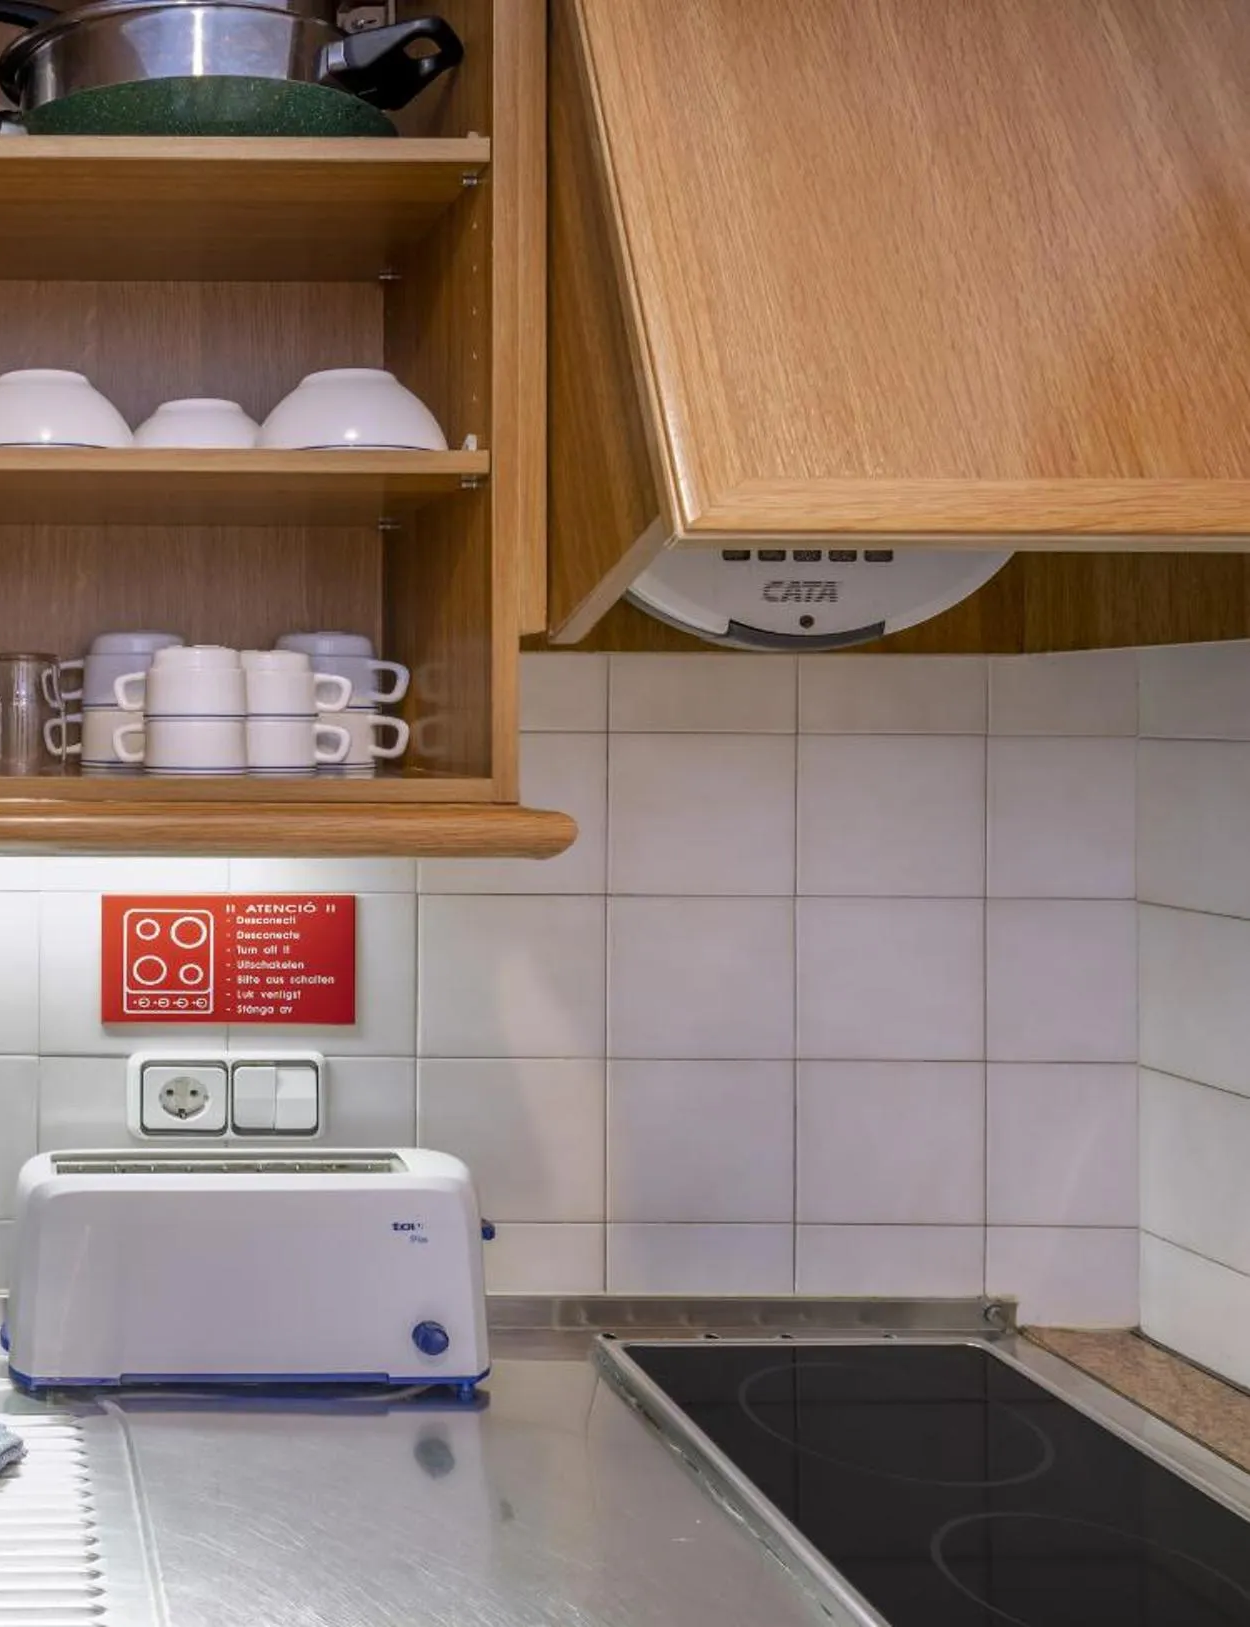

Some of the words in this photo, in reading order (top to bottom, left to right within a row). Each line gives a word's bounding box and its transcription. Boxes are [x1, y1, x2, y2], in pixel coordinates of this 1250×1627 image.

[762, 580, 839, 602] CATA
[246, 901, 317, 913] ATENCIÓ
[266, 975, 284, 985] aus
[280, 1005, 293, 1014] av
